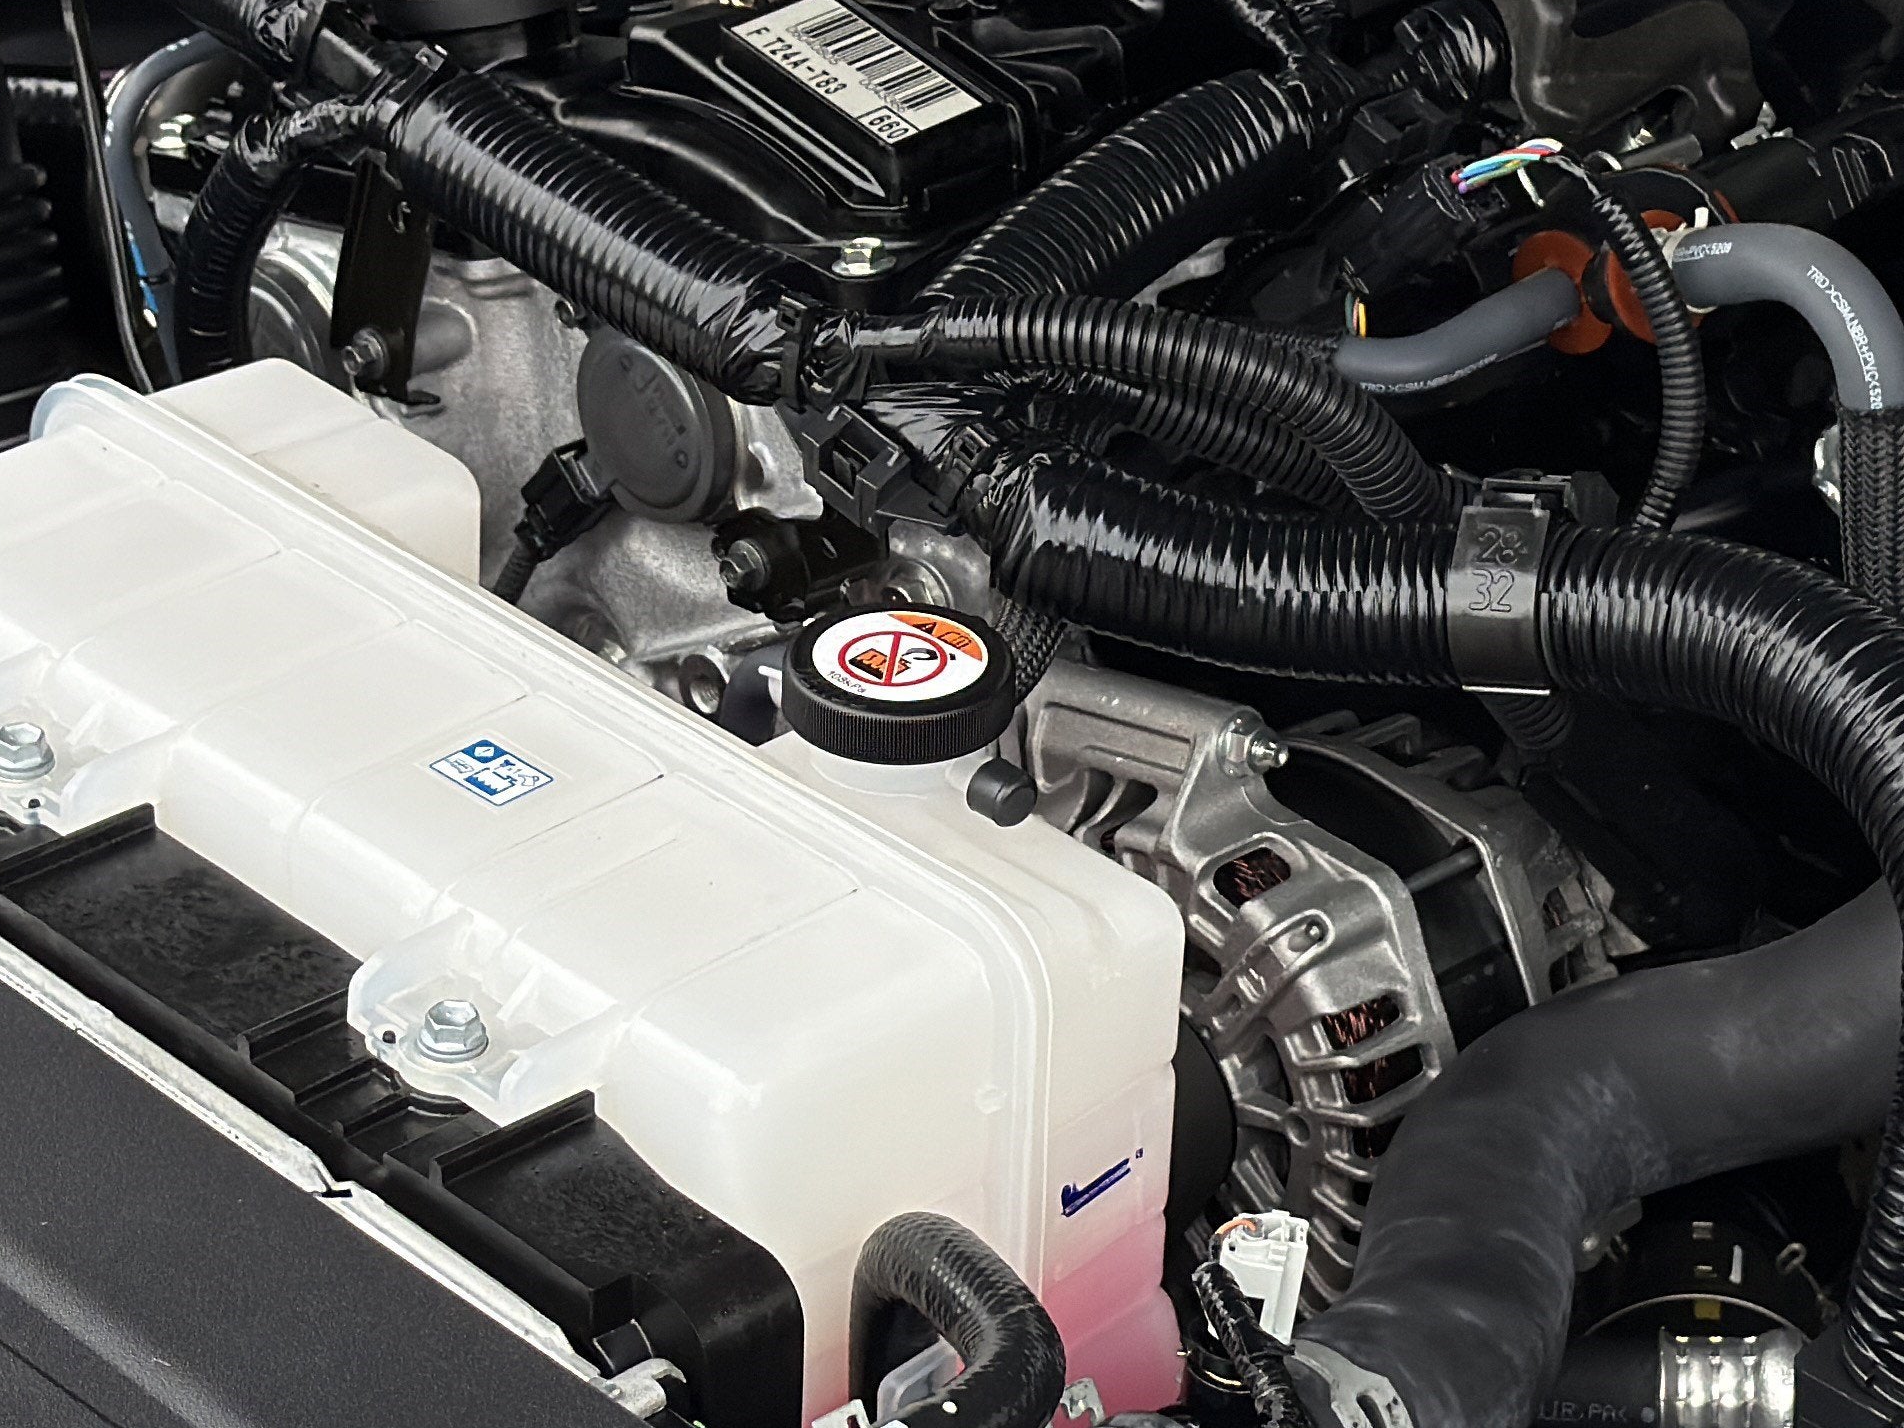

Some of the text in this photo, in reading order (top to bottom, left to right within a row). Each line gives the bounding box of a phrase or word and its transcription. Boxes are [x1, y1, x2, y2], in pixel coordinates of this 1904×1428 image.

[747, 26, 770, 37] F
[869, 113, 910, 139] 660
[1806, 264, 1830, 289] TRD
[1468, 568, 1515, 613] 32
